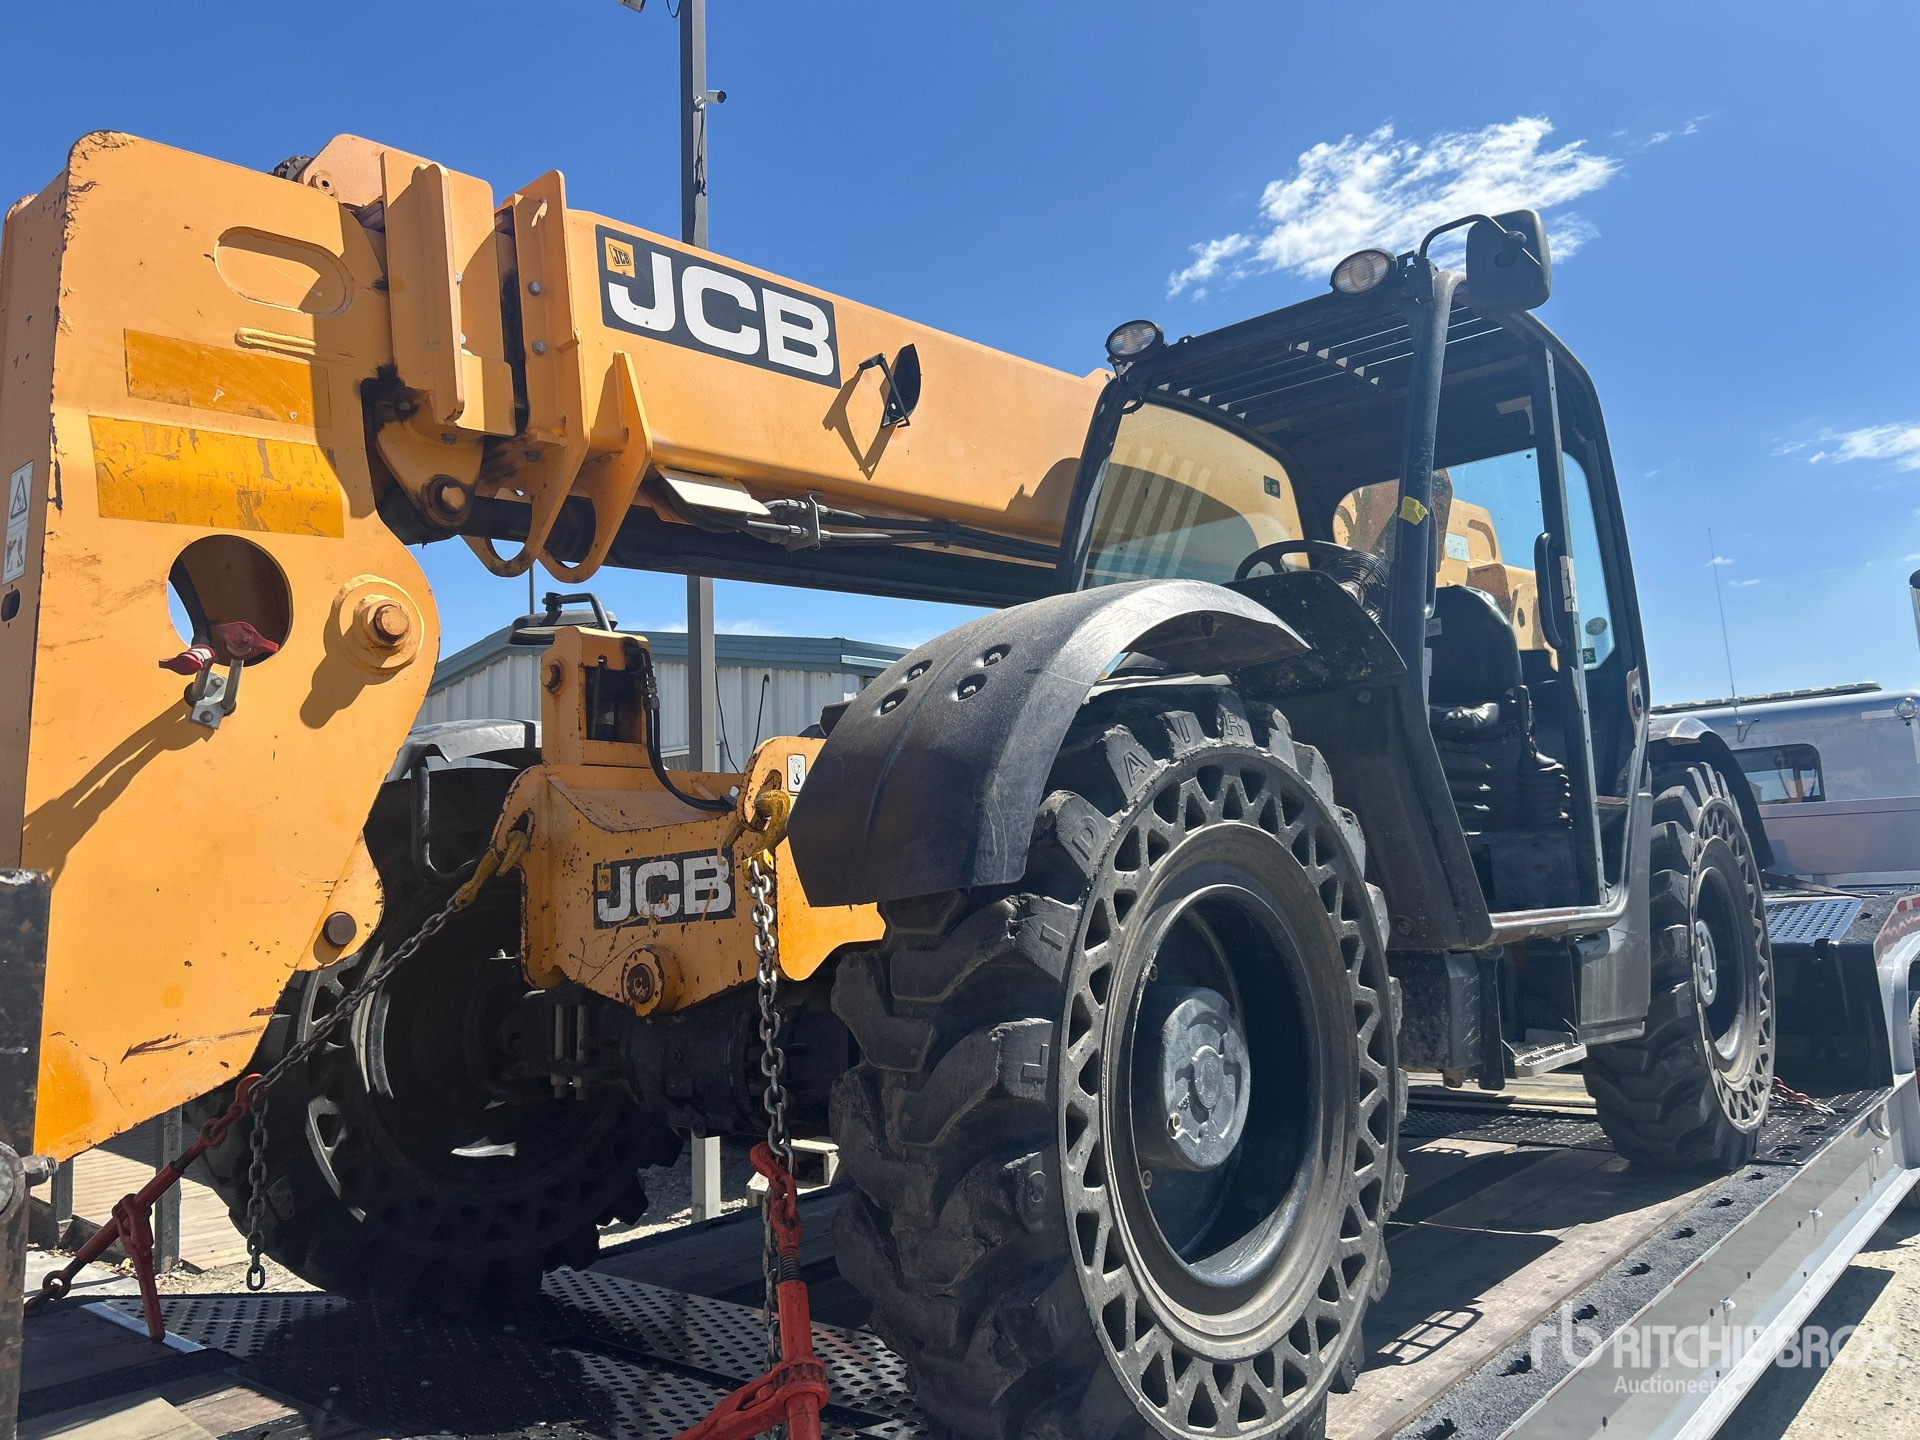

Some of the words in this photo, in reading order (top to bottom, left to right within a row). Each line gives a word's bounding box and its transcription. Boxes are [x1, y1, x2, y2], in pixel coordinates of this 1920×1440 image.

[612, 247, 630, 265] JCB
[608, 252, 834, 376] JCB
[598, 855, 731, 922] JCB
